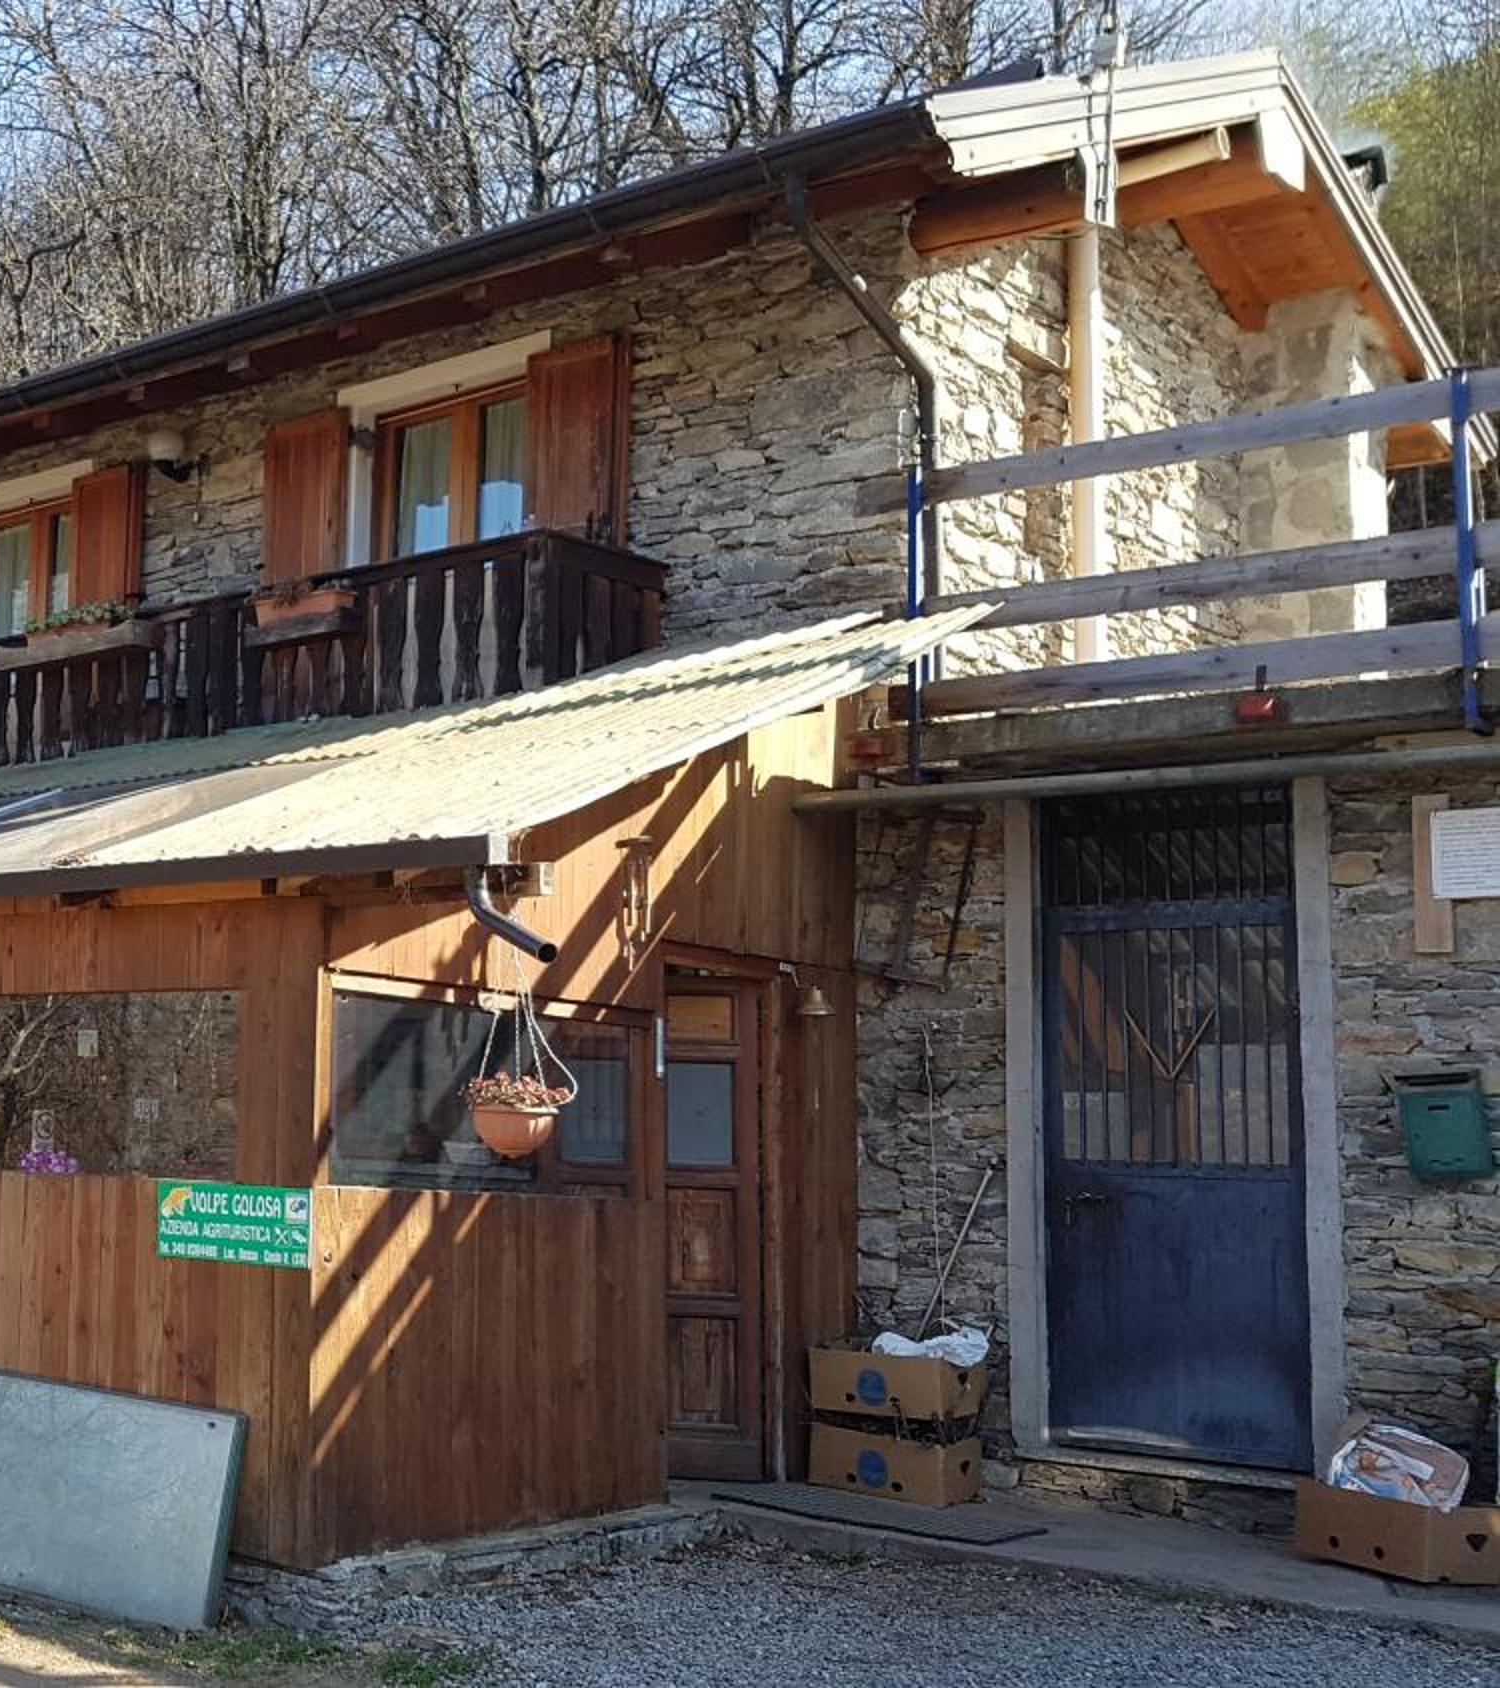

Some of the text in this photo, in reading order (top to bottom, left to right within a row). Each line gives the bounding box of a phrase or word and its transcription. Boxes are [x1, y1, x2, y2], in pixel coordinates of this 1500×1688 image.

[191, 1191, 281, 1218] VOLPE GOLOSA
[160, 1219, 271, 1243] AZIENDA AGRITURISTICA
